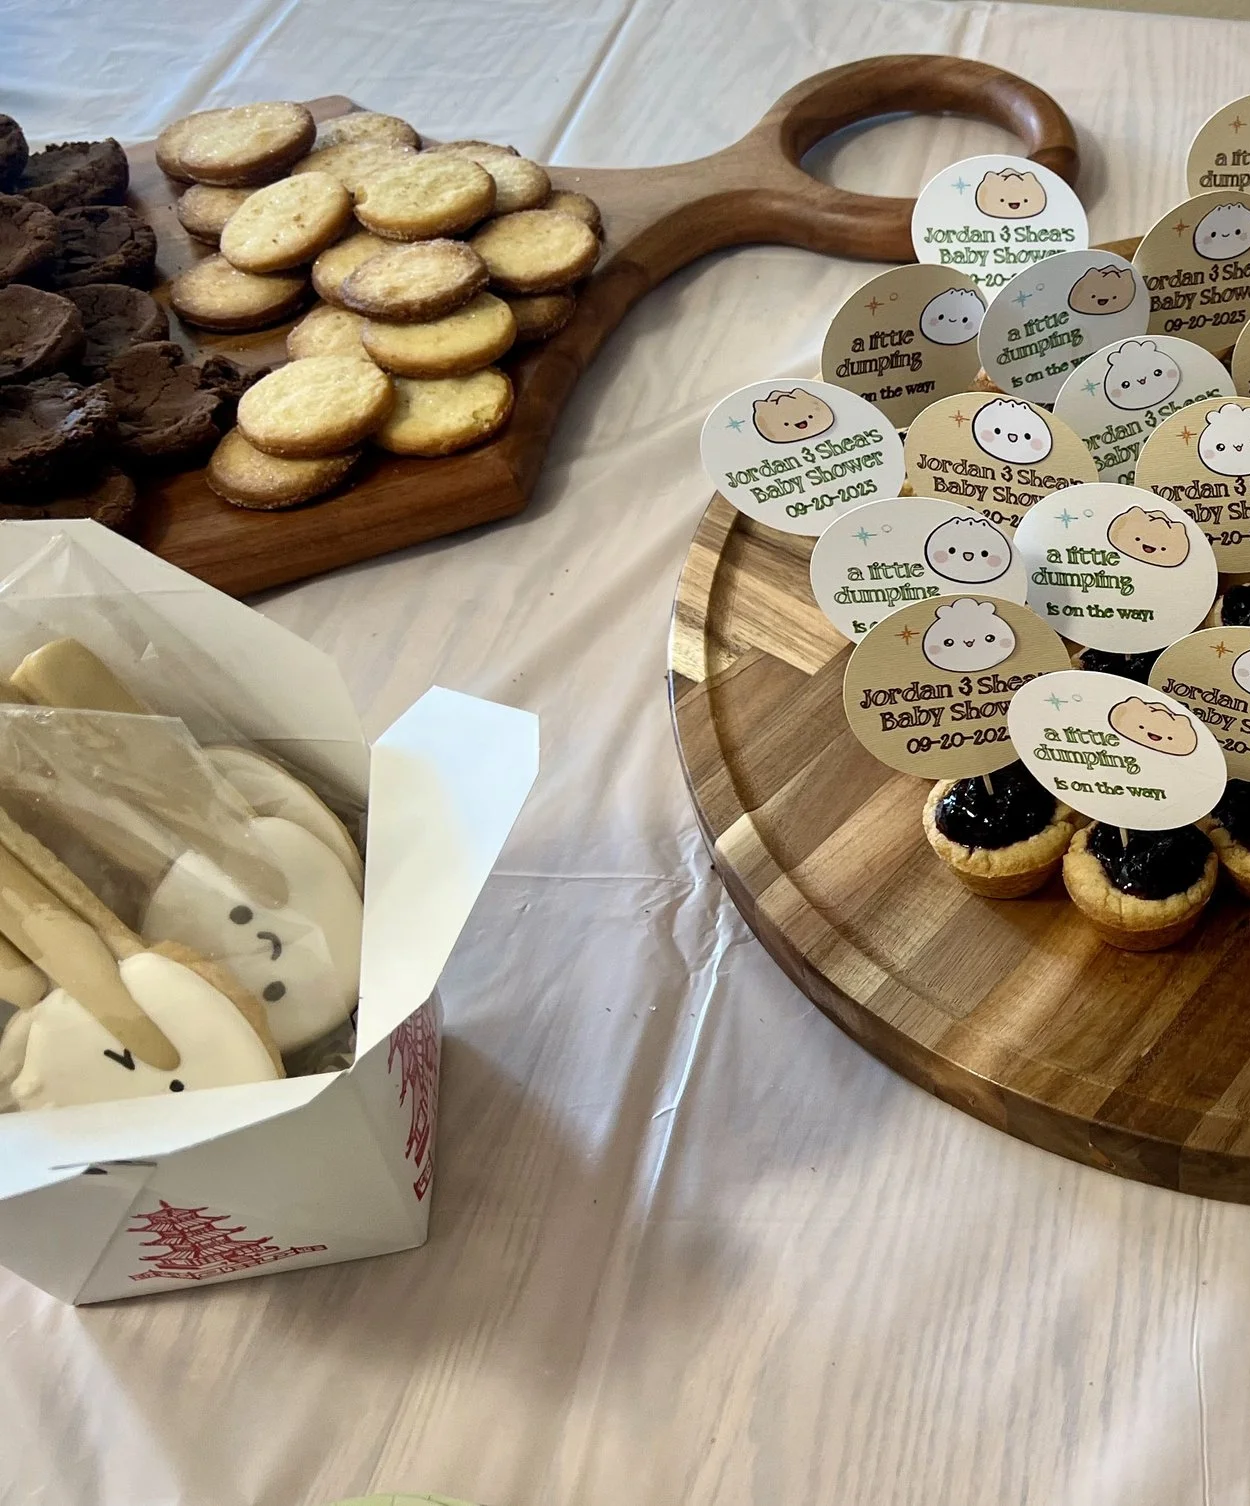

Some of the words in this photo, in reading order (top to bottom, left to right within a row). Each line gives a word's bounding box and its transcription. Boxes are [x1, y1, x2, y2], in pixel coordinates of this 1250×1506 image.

[1215, 151, 1227, 166] a
[924, 226, 995, 243] Jordan
[1014, 225, 1076, 242] Shea's
[939, 247, 989, 266] Baby
[1150, 292, 1197, 311] Baby
[1008, 327, 1021, 341] a
[1025, 311, 1070, 337] little
[1164, 310, 1246, 332] 09-20-2025
[852, 338, 864, 353] a
[869, 330, 915, 351] little
[997, 328, 1084, 365] dumpling
[836, 352, 922, 378] dumpling
[1012, 375, 1023, 388] is
[1025, 370, 1043, 382] on
[1045, 361, 1068, 377] the
[880, 386, 903, 400] the
[726, 456, 804, 488] Jordan
[815, 429, 884, 460] Shea's
[917, 454, 997, 481] Jordan
[750, 475, 806, 504] Baby
[805, 451, 886, 486] Shower
[933, 476, 989, 502] Baby
[786, 479, 878, 518] 09-20-2025
[1183, 505, 1223, 524] aby
[1047, 548, 1063, 564] a
[1066, 546, 1120, 567] little
[847, 567, 865, 581] a
[867, 562, 924, 580] little
[1031, 567, 1134, 596] dumpling
[1046, 602, 1060, 616] is
[1062, 605, 1084, 617] on
[1087, 604, 1114, 619] the
[852, 620, 867, 633] is
[859, 681, 954, 709] Jordan
[1162, 678, 1249, 713] Jordan
[880, 705, 945, 732] Baby
[1178, 702, 1237, 732] aby
[906, 726, 1011, 754] 09-20-202
[1043, 728, 1061, 742] a
[1062, 727, 1120, 747] little
[1034, 744, 1141, 775] dumpling
[1054, 777, 1069, 790] is
[1071, 781, 1094, 793] on
[1095, 782, 1124, 795] the
